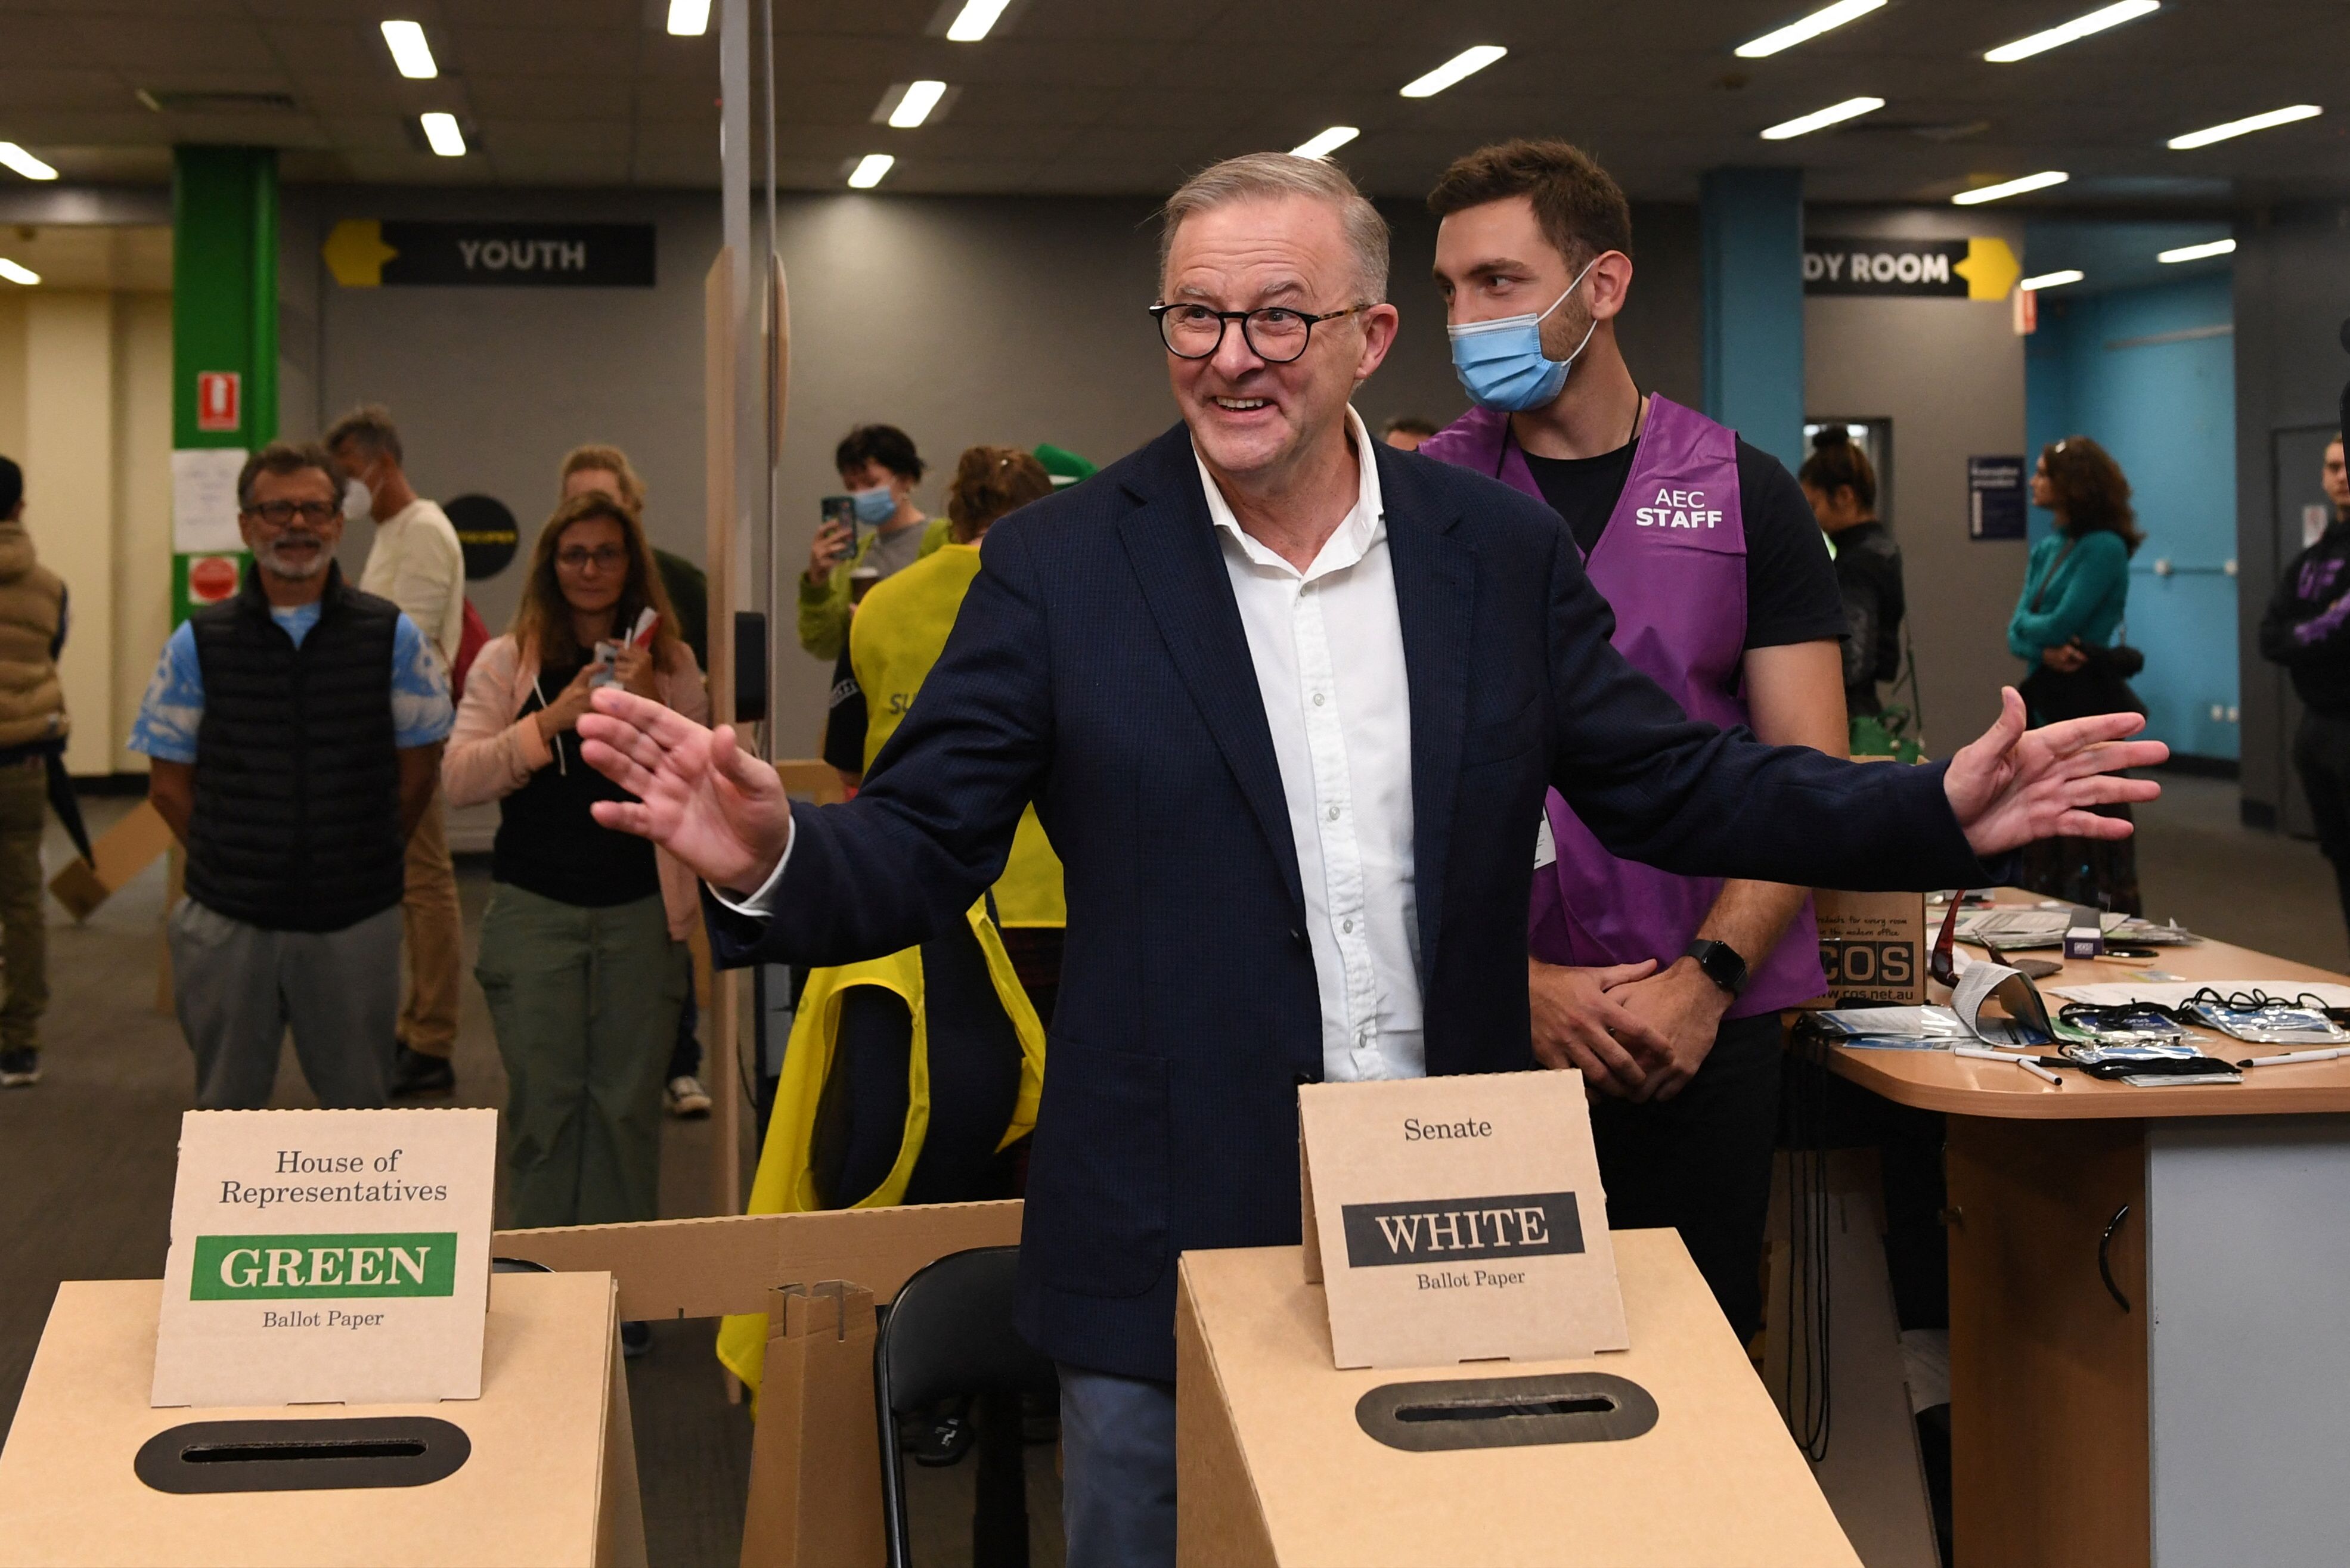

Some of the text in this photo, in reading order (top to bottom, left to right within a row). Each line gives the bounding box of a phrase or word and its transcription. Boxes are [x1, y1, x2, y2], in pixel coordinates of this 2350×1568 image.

[458, 241, 586, 270] YOUTH
[1803, 253, 1949, 284] DY ROOM
[1655, 488, 1705, 508] AEC
[1636, 507, 1722, 529] STAFF
[1815, 915, 1845, 924] roducts
[1819, 946, 1910, 981] COS
[1403, 1117, 1493, 1142] Senate
[275, 1149, 403, 1174] House of
[219, 1179, 448, 1209] Representatives
[1375, 1206, 1549, 1255] WHITE
[219, 1246, 431, 1288] GREEN
[1416, 1270, 1526, 1290] Ballot Paper
[262, 1311, 385, 1330] Ballot Paper
